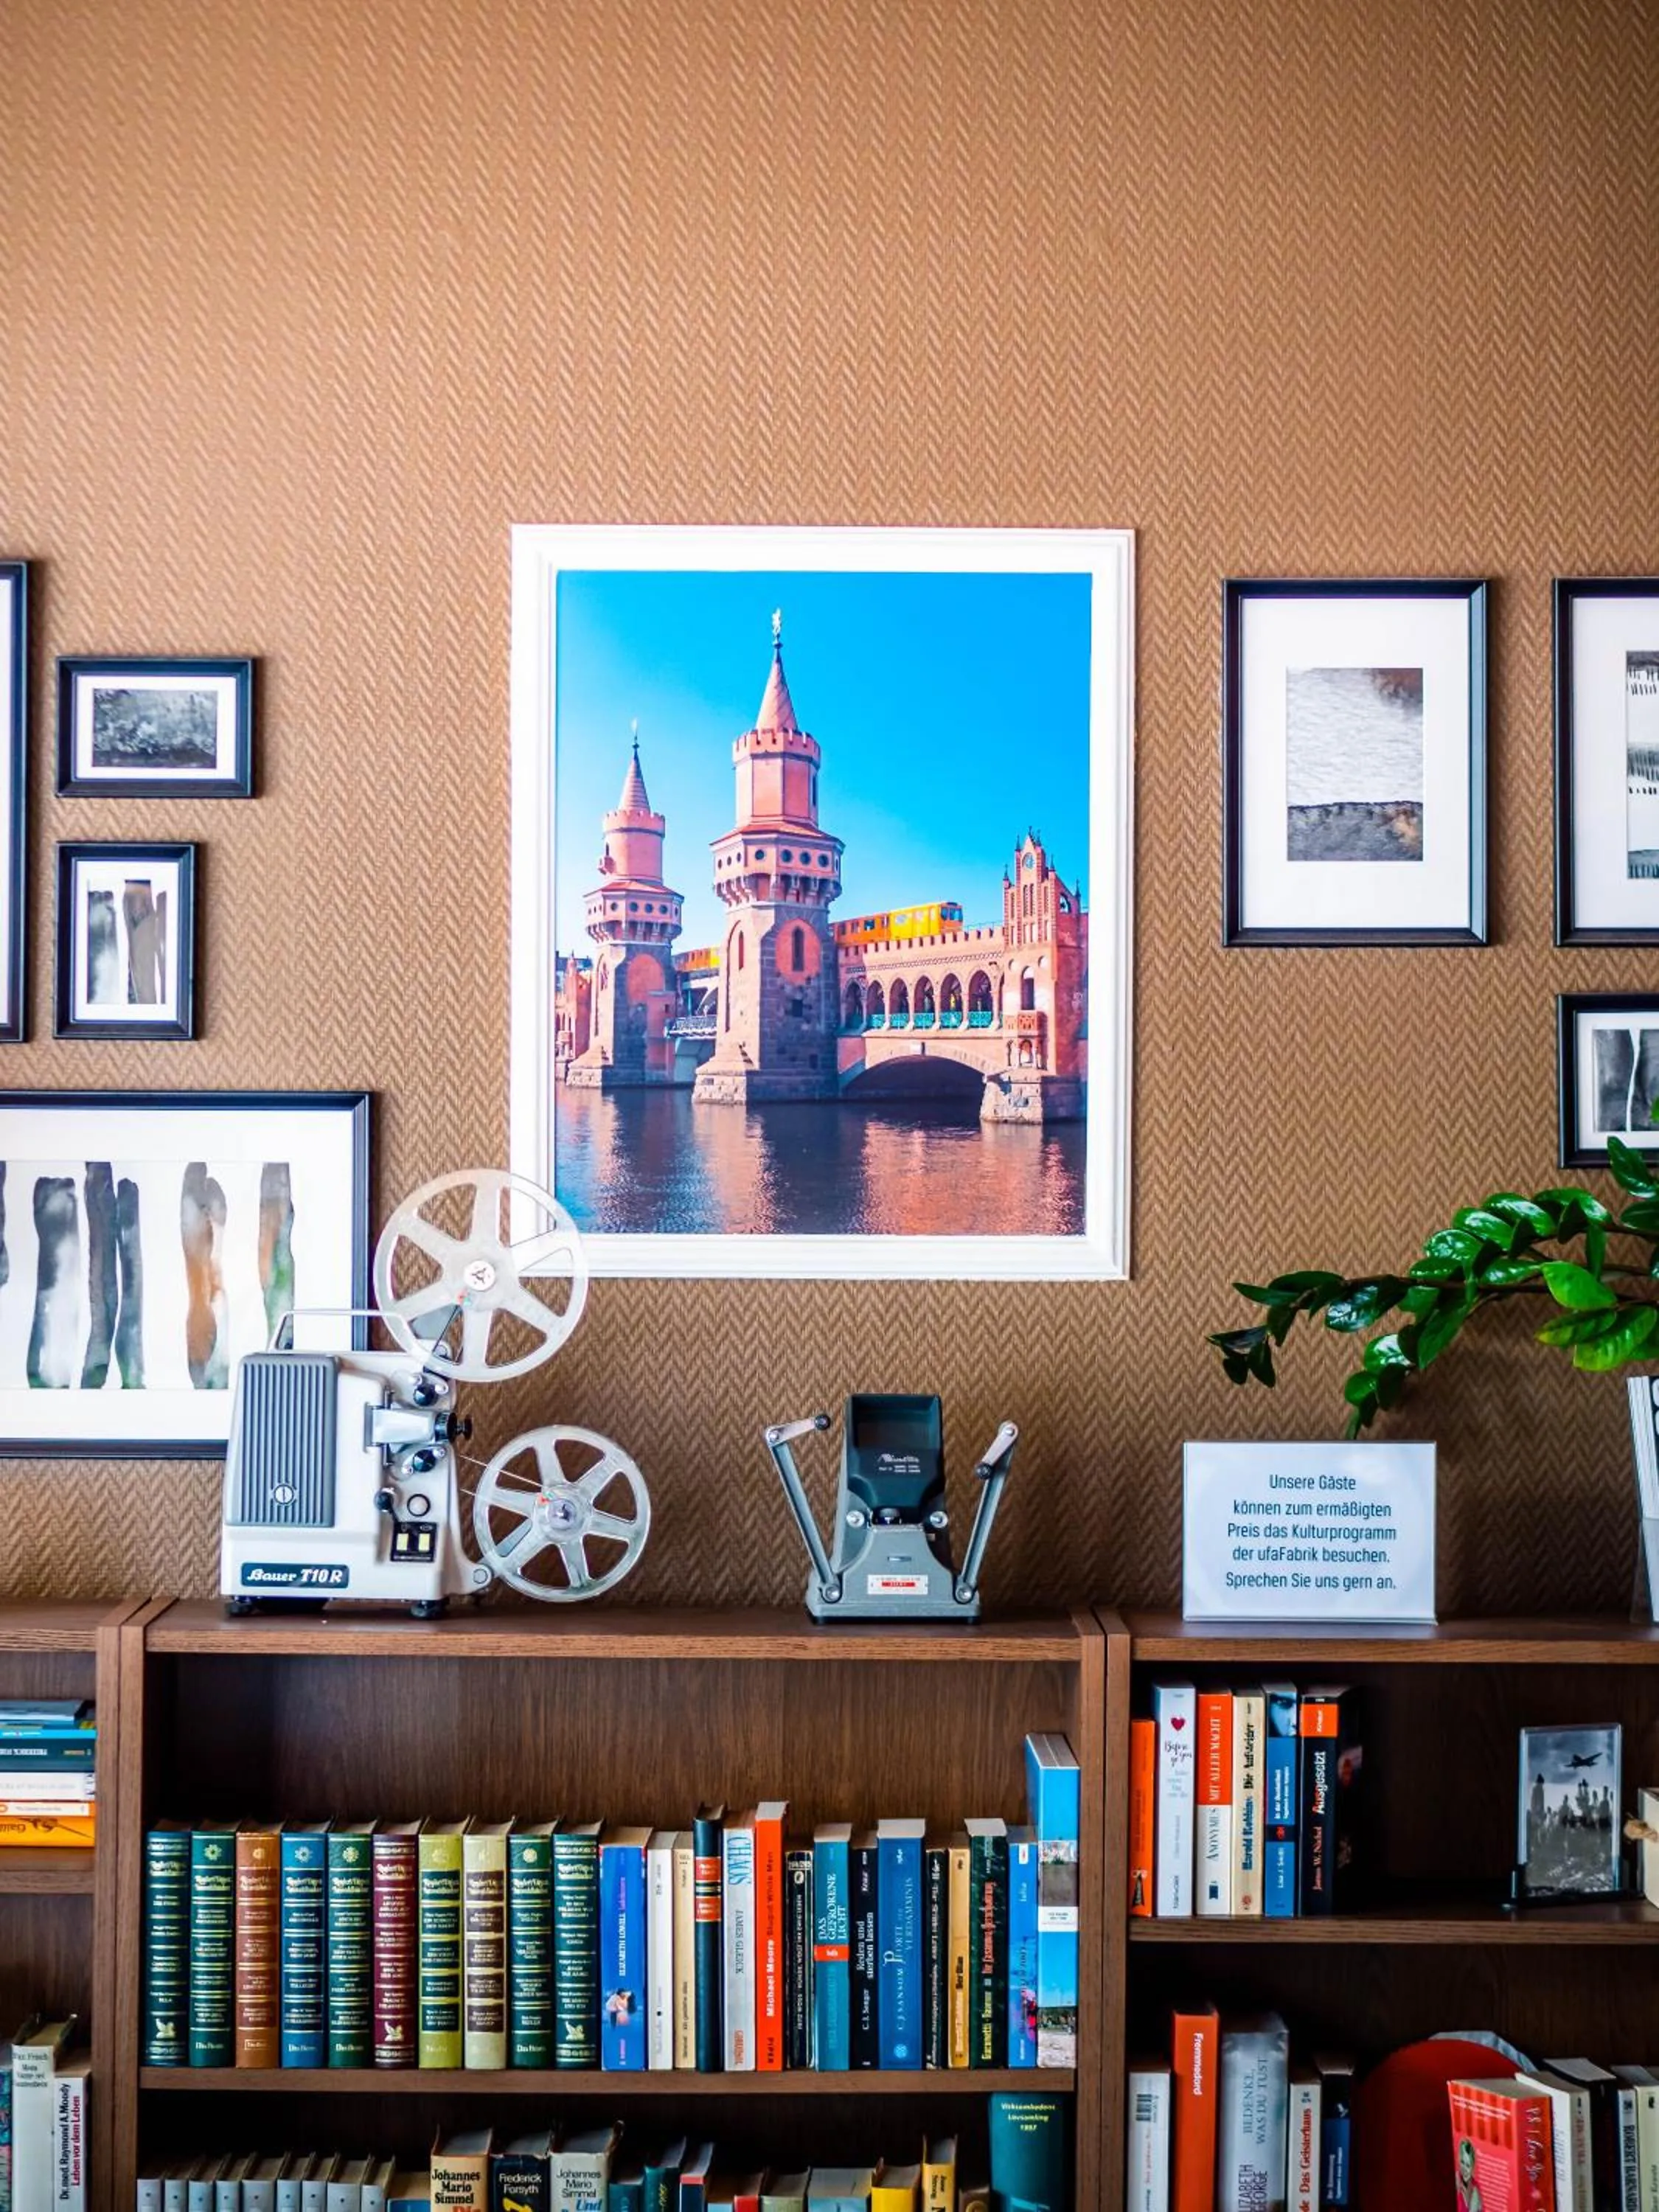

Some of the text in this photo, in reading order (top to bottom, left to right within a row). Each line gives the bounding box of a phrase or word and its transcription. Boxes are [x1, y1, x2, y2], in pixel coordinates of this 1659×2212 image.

[1269, 1474, 1357, 1490] Unsere Gäste
[1234, 1500, 1392, 1520] können zum ermäßigten
[1228, 1523, 1397, 1543] Preis das Kulturprogramm
[1232, 1545, 1390, 1562] der ufaFabrik besuchen.
[247, 1568, 297, 1582] Bauer
[1225, 1571, 1397, 1591] Sprechen Sie uns gern an.
[1312, 1751, 1327, 1815] Ausgesetzt
[727, 1837, 751, 1885] CHAOS
[1242, 1838, 1253, 1870] Harold
[827, 1874, 836, 1940] GEFRORENE
[735, 1910, 744, 1939] JAMES
[818, 1917, 827, 1940] DAS
[838, 1905, 847, 1939] LICHT
[766, 1939, 774, 1973] Moore
[856, 1921, 866, 1971] Reden und
[866, 1912, 874, 1979] sterben lassen
[766, 1975, 774, 2017] Michael
[1193, 2032, 1204, 2096] Fremmedord
[59, 2083, 72, 2114] Moody
[71, 2096, 80, 2123] Leben
[1256, 2058, 1268, 2144] WAS DU TUST
[59, 2124, 72, 2165] Raymond
[71, 2124, 80, 2143] dem
[1299, 2107, 1312, 2194] Das Geisterhaus
[71, 2159, 80, 2186] Leben
[431, 2168, 481, 2181] Johannes
[498, 2172, 542, 2184] Frederick
[557, 2169, 602, 2180] Johannes
[566, 2180, 593, 2189] Mario
[59, 2188, 70, 2200] Dr.
[435, 2193, 474, 2205] Simmel
[442, 2180, 472, 2193] Mario
[504, 2183, 539, 2195] Forsyth
[561, 2189, 597, 2199] Simmel
